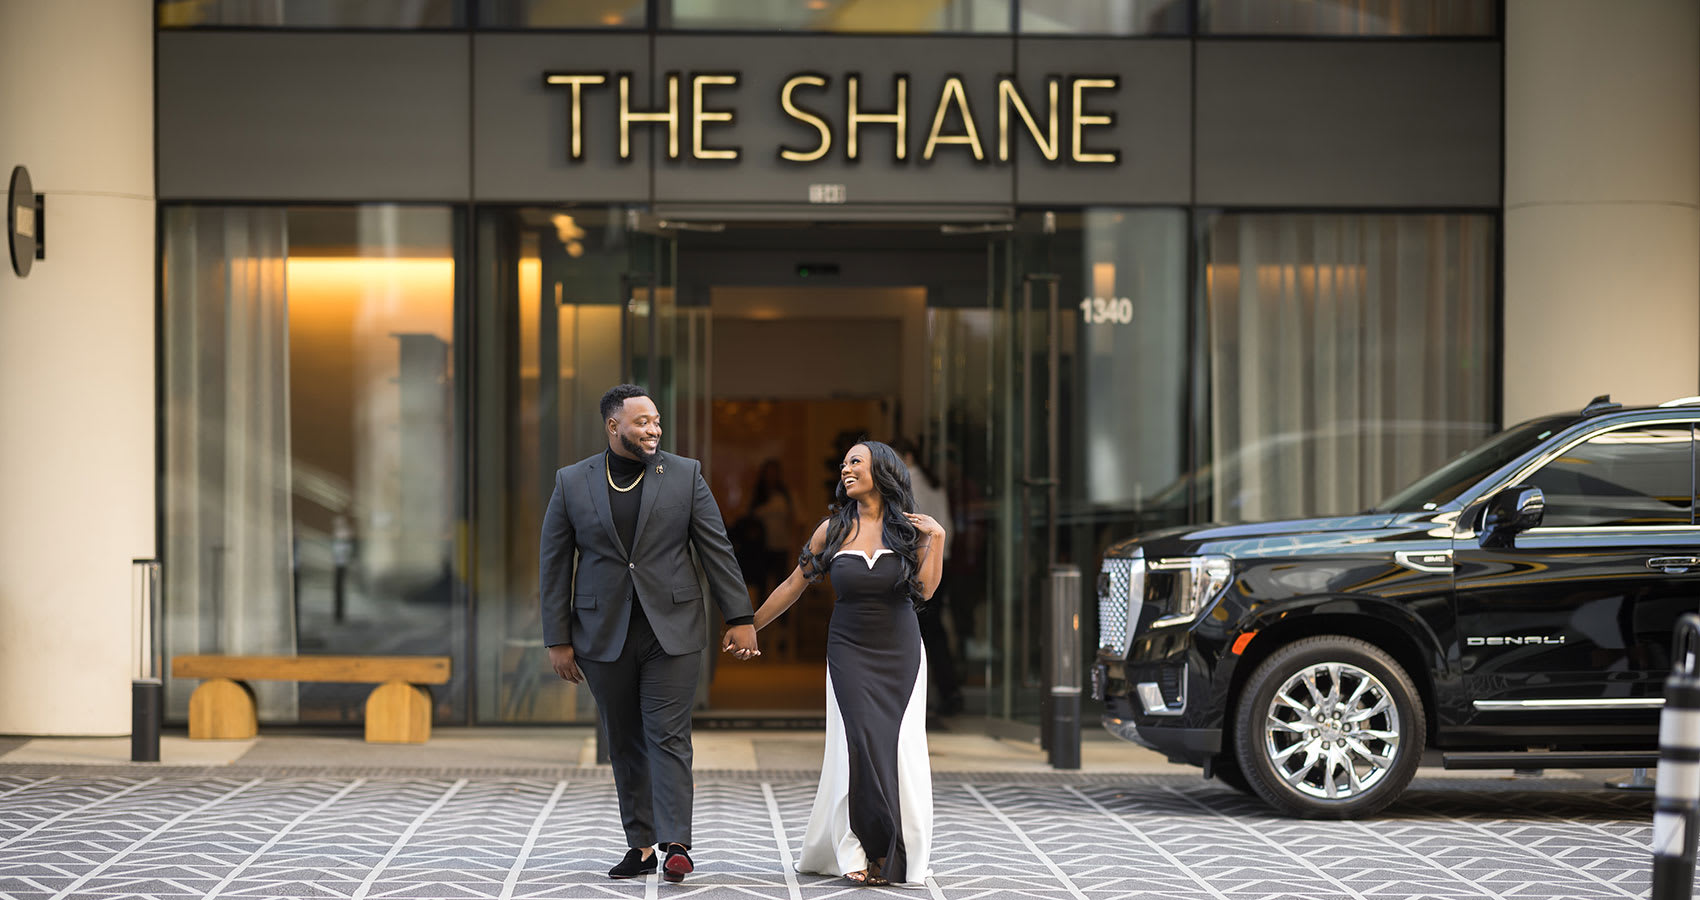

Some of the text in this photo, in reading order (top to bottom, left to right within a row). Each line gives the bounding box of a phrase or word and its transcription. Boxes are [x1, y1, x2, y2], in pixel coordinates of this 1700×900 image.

[546, 74, 1117, 163] THE SHANE
[1080, 297, 1133, 324] 1340
[1467, 635, 1566, 646] DENALI
